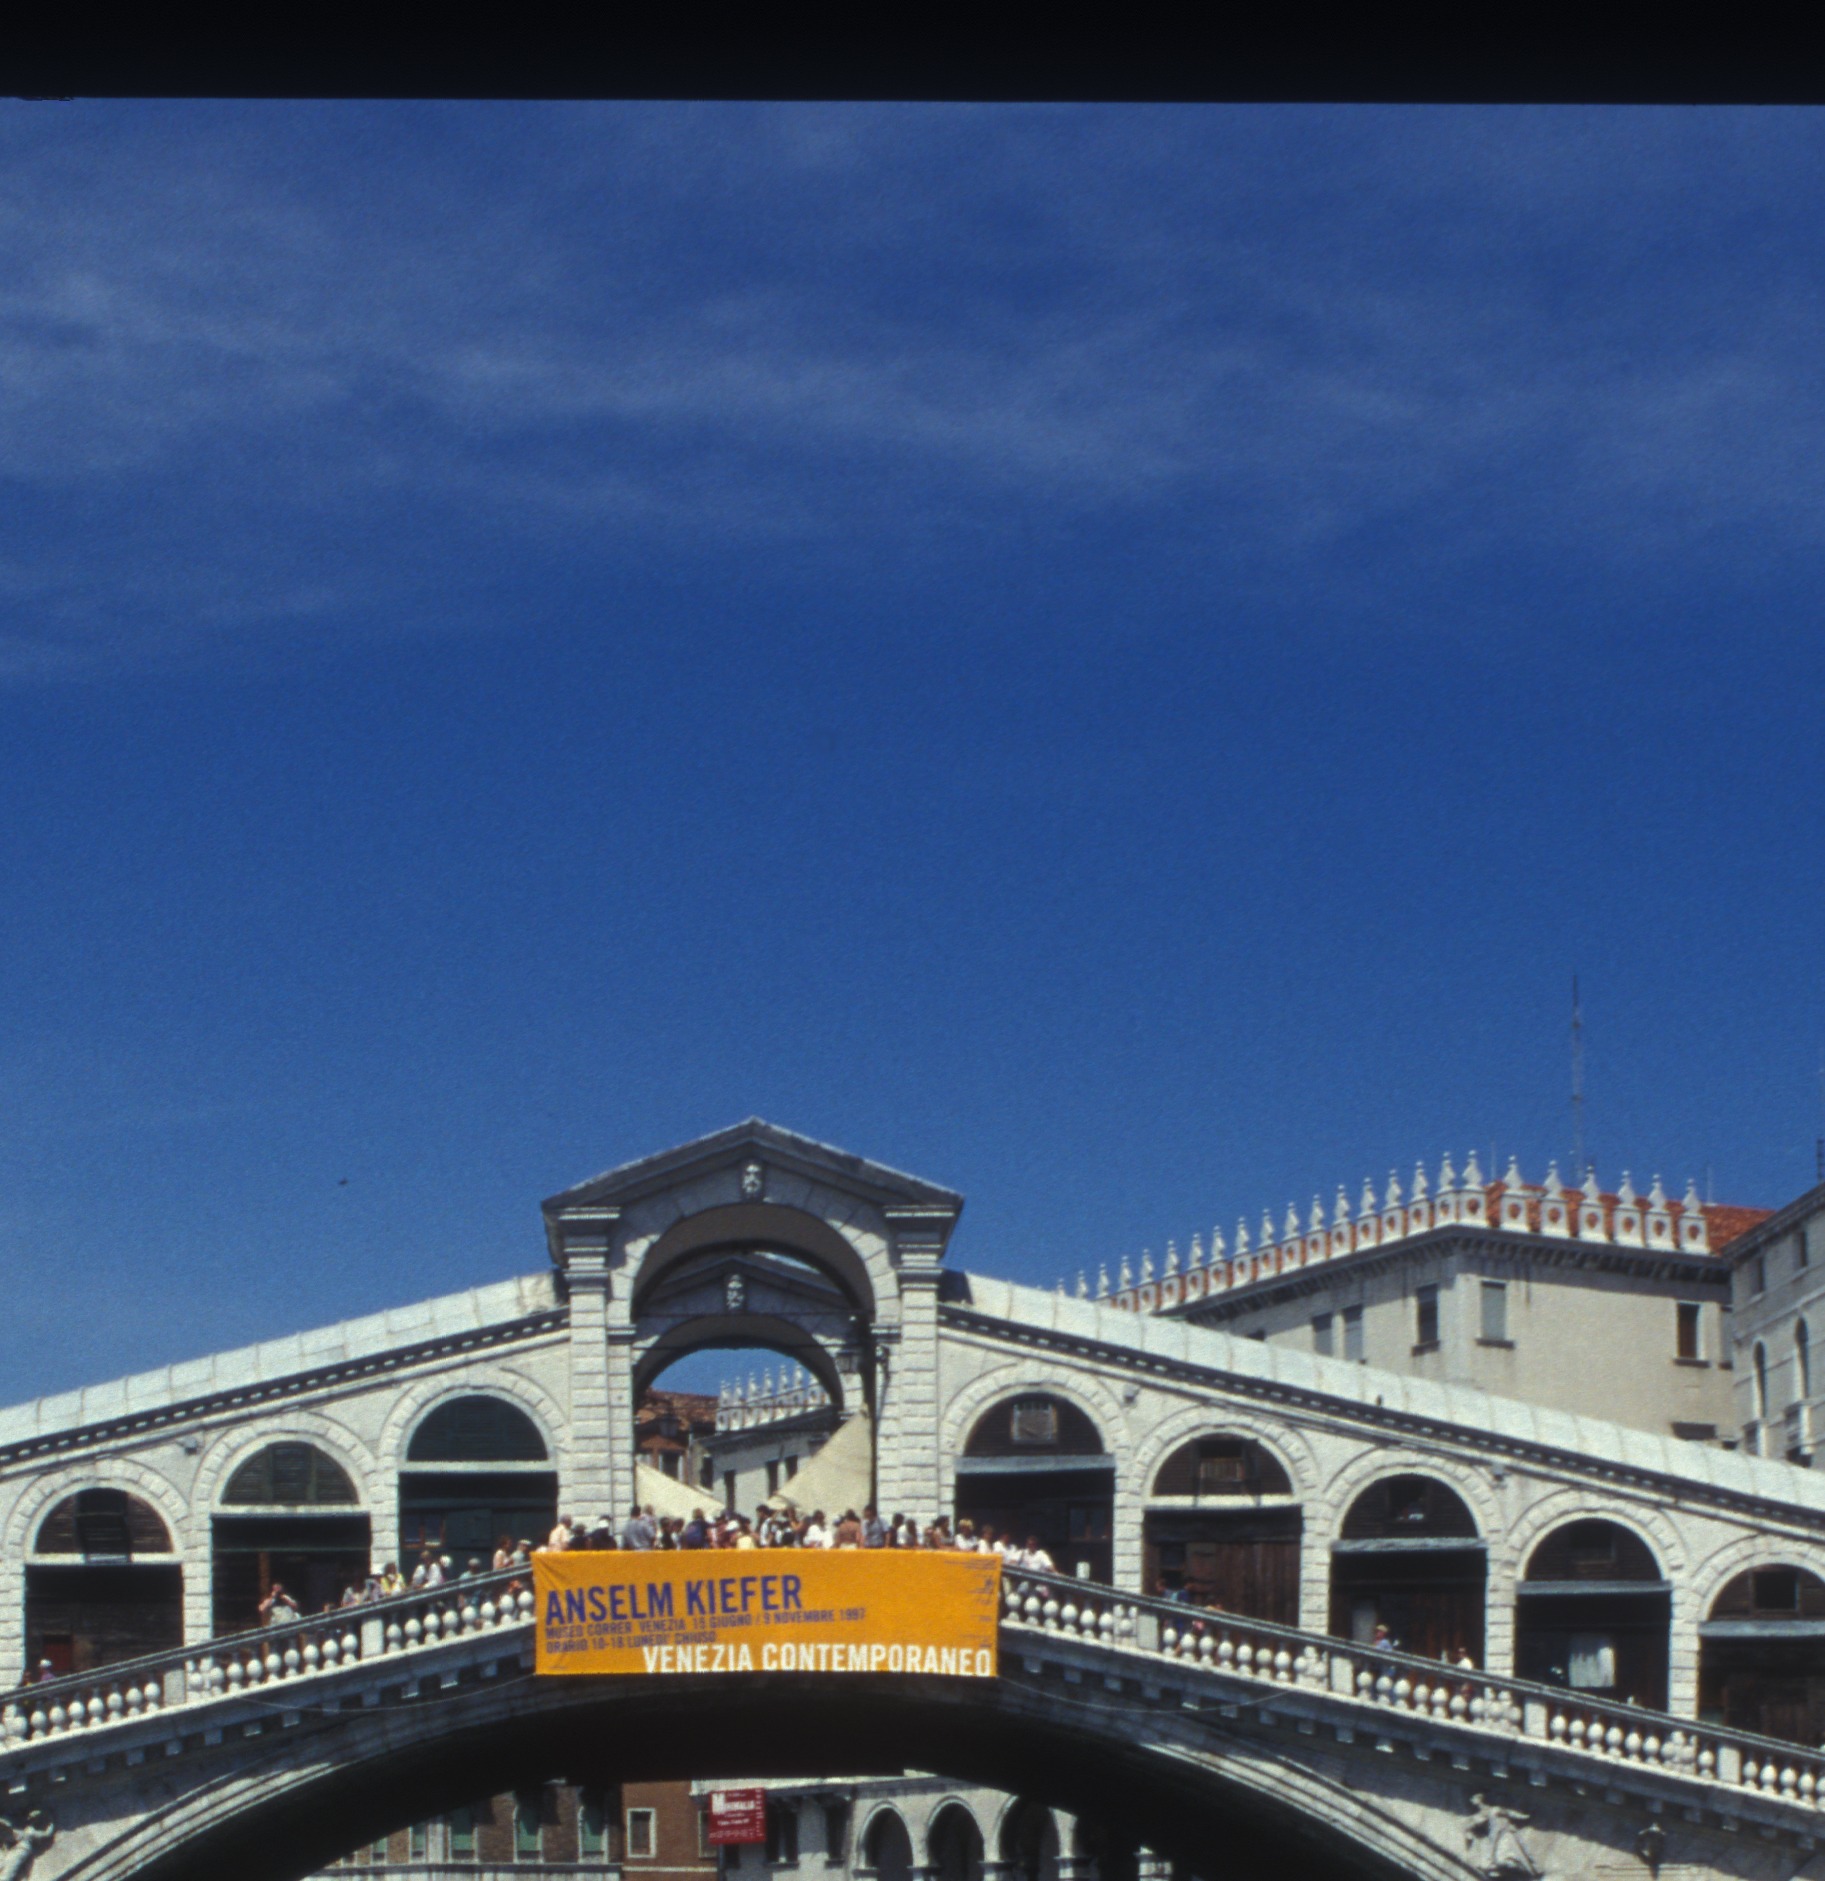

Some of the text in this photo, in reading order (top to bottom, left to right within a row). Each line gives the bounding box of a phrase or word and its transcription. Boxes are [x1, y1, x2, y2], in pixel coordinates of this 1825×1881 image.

[545, 1574, 802, 1626] ANSELM KIEFER
[545, 1625, 584, 1639] MUSEO
[587, 1621, 632, 1637] CORRER
[639, 1618, 686, 1633] VENEZIA
[693, 1616, 706, 1630] 15
[709, 1613, 752, 1629] GIUGNO
[763, 1611, 771, 1625] 9
[774, 1608, 835, 1624] NOVEMBRE
[840, 1607, 866, 1621] 1997
[546, 1638, 588, 1654] ORARIO
[593, 1635, 624, 1651] 10-18
[674, 1630, 716, 1645] CHIUSO
[642, 1642, 992, 1677] VENEZIA CONTEMPORANEO
